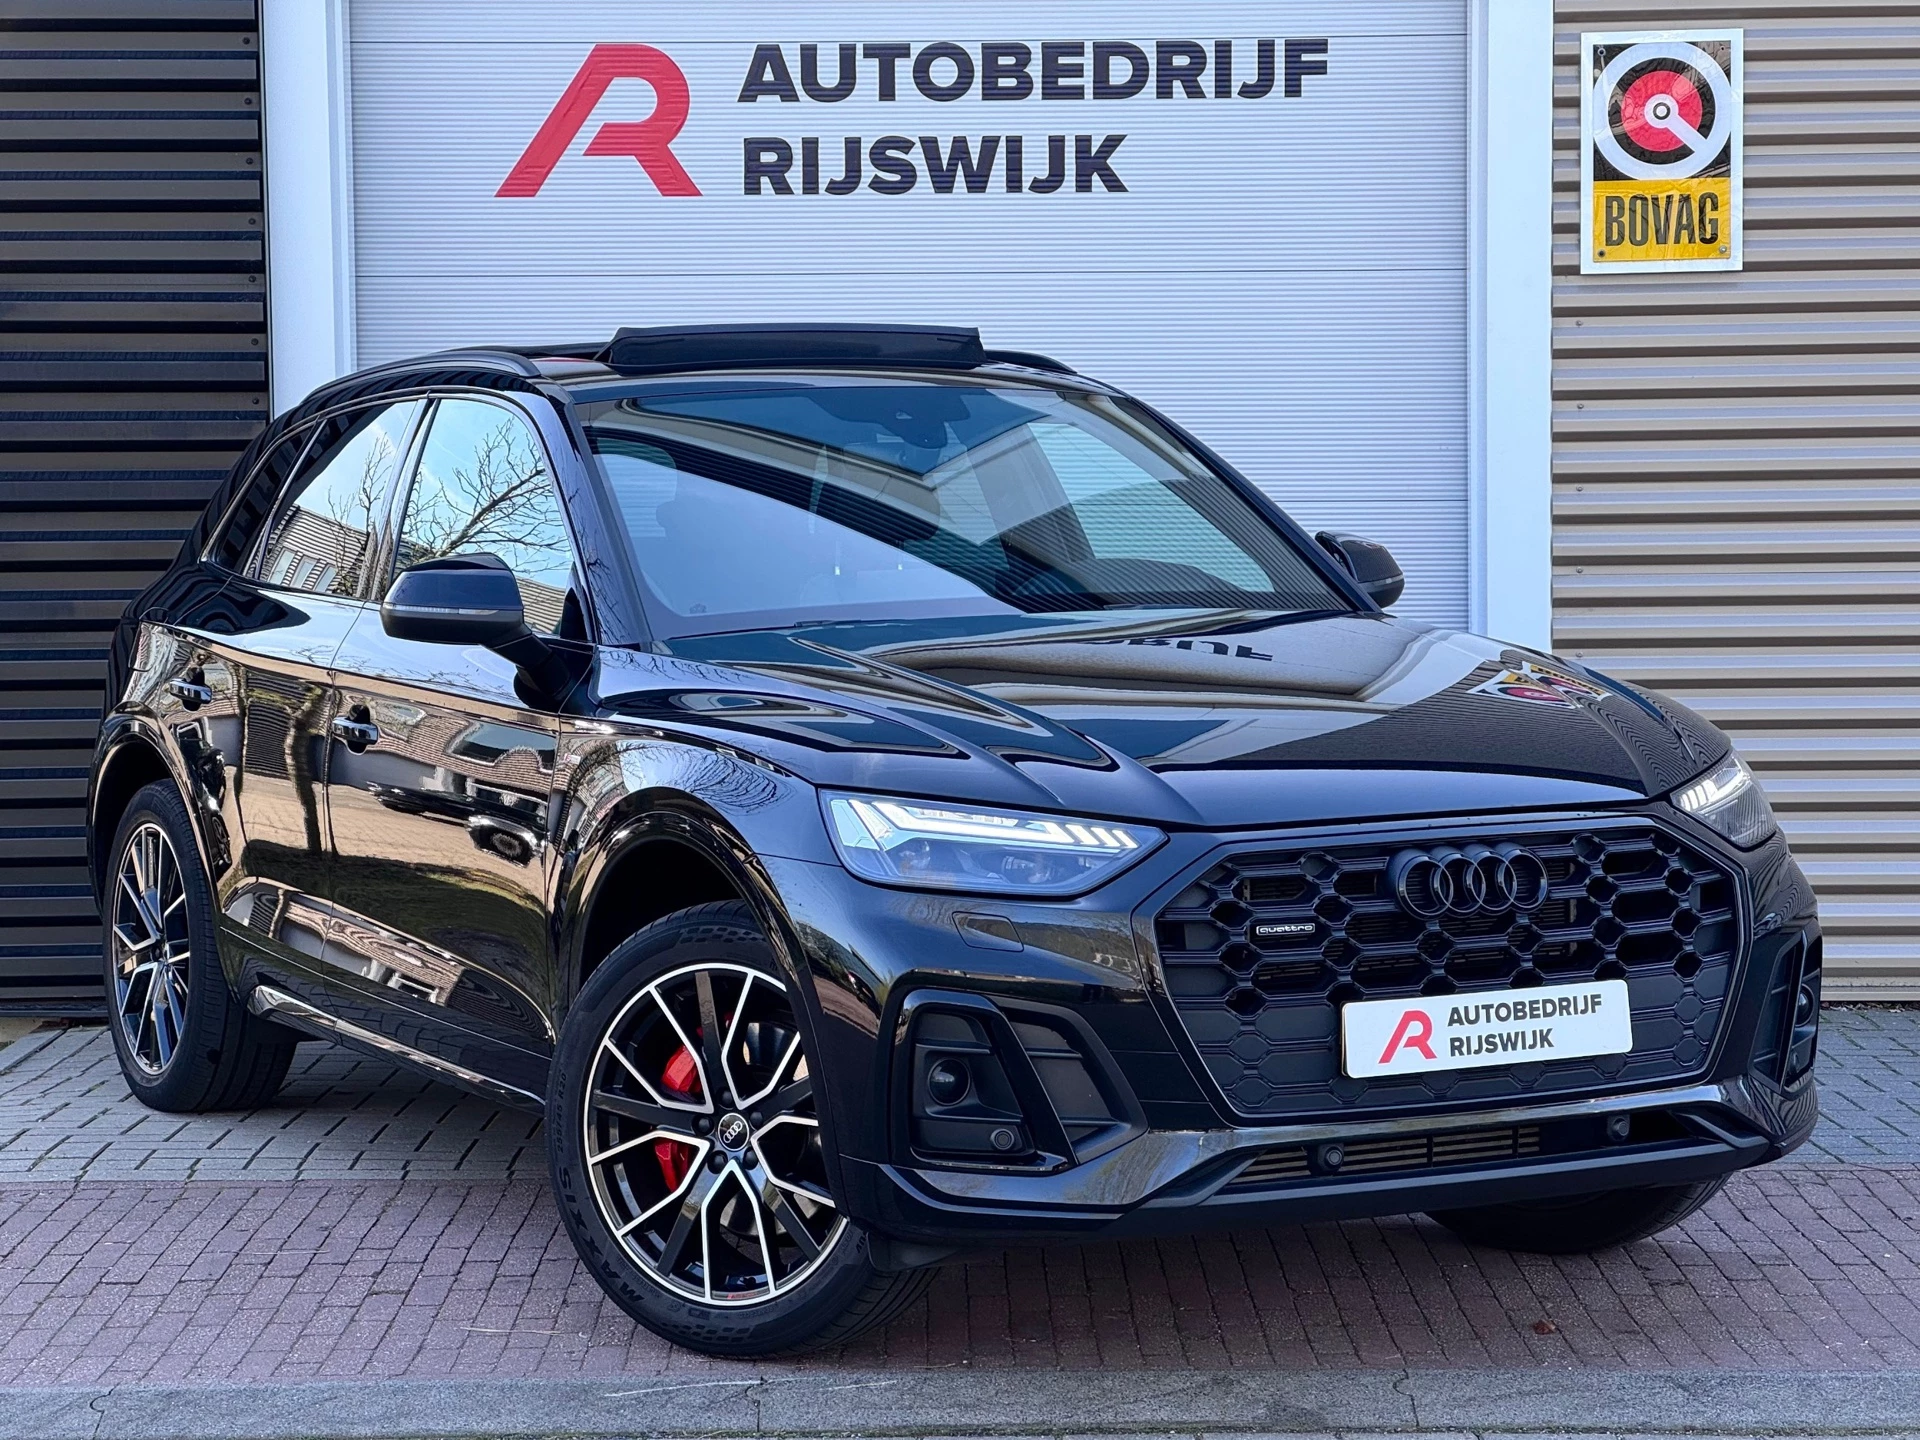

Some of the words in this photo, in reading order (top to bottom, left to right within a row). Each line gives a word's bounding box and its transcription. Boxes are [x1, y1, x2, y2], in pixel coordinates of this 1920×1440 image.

[738, 38, 1329, 103] AUTOBEDRIJF
[743, 134, 1129, 195] RIJSWIJK
[1605, 192, 1719, 246] BOVAG
[1259, 924, 1314, 935] quattro
[1447, 993, 1602, 1027] AUTOBEDRIJF
[1449, 1028, 1554, 1057] RIJSWIJK
[558, 1072, 567, 1100] R20
[555, 1104, 564, 1154] 255/45
[558, 1166, 646, 1302] MAXXIS
